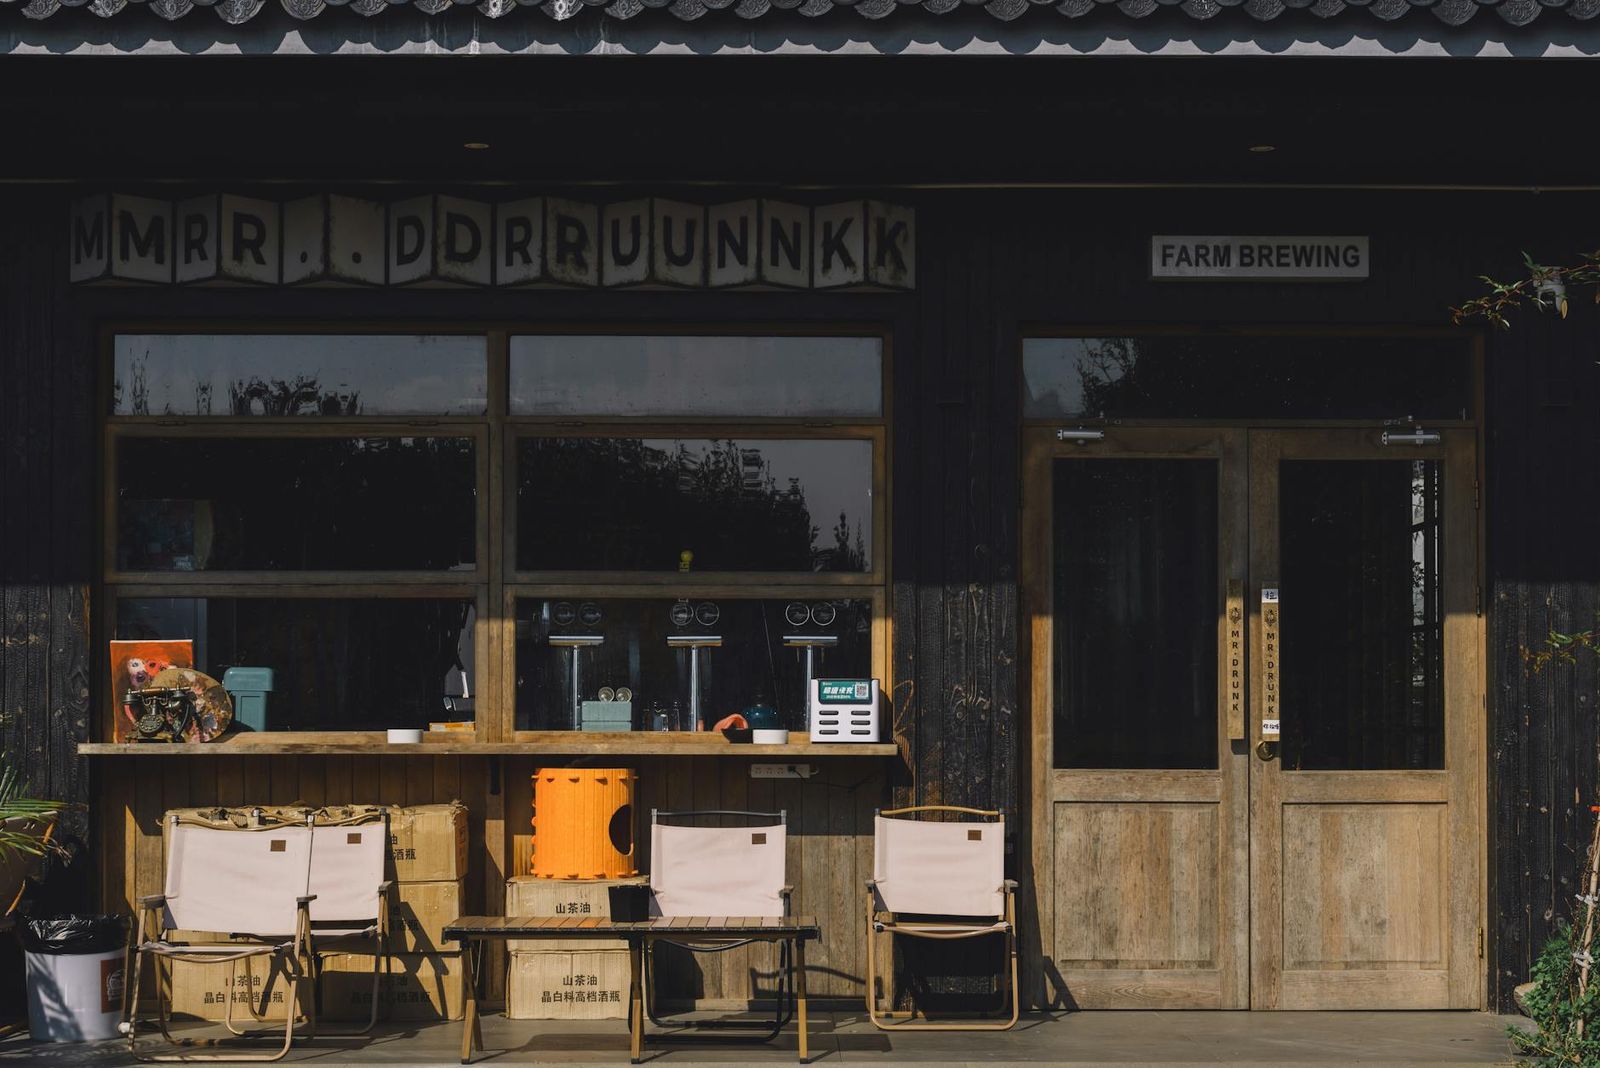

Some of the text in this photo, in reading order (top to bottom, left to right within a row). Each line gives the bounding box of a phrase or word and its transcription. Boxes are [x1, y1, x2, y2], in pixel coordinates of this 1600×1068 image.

[1161, 244, 1361, 268] FARM BREWING
[555, 902, 591, 914] 山茶油
[562, 974, 598, 986] 山茶油
